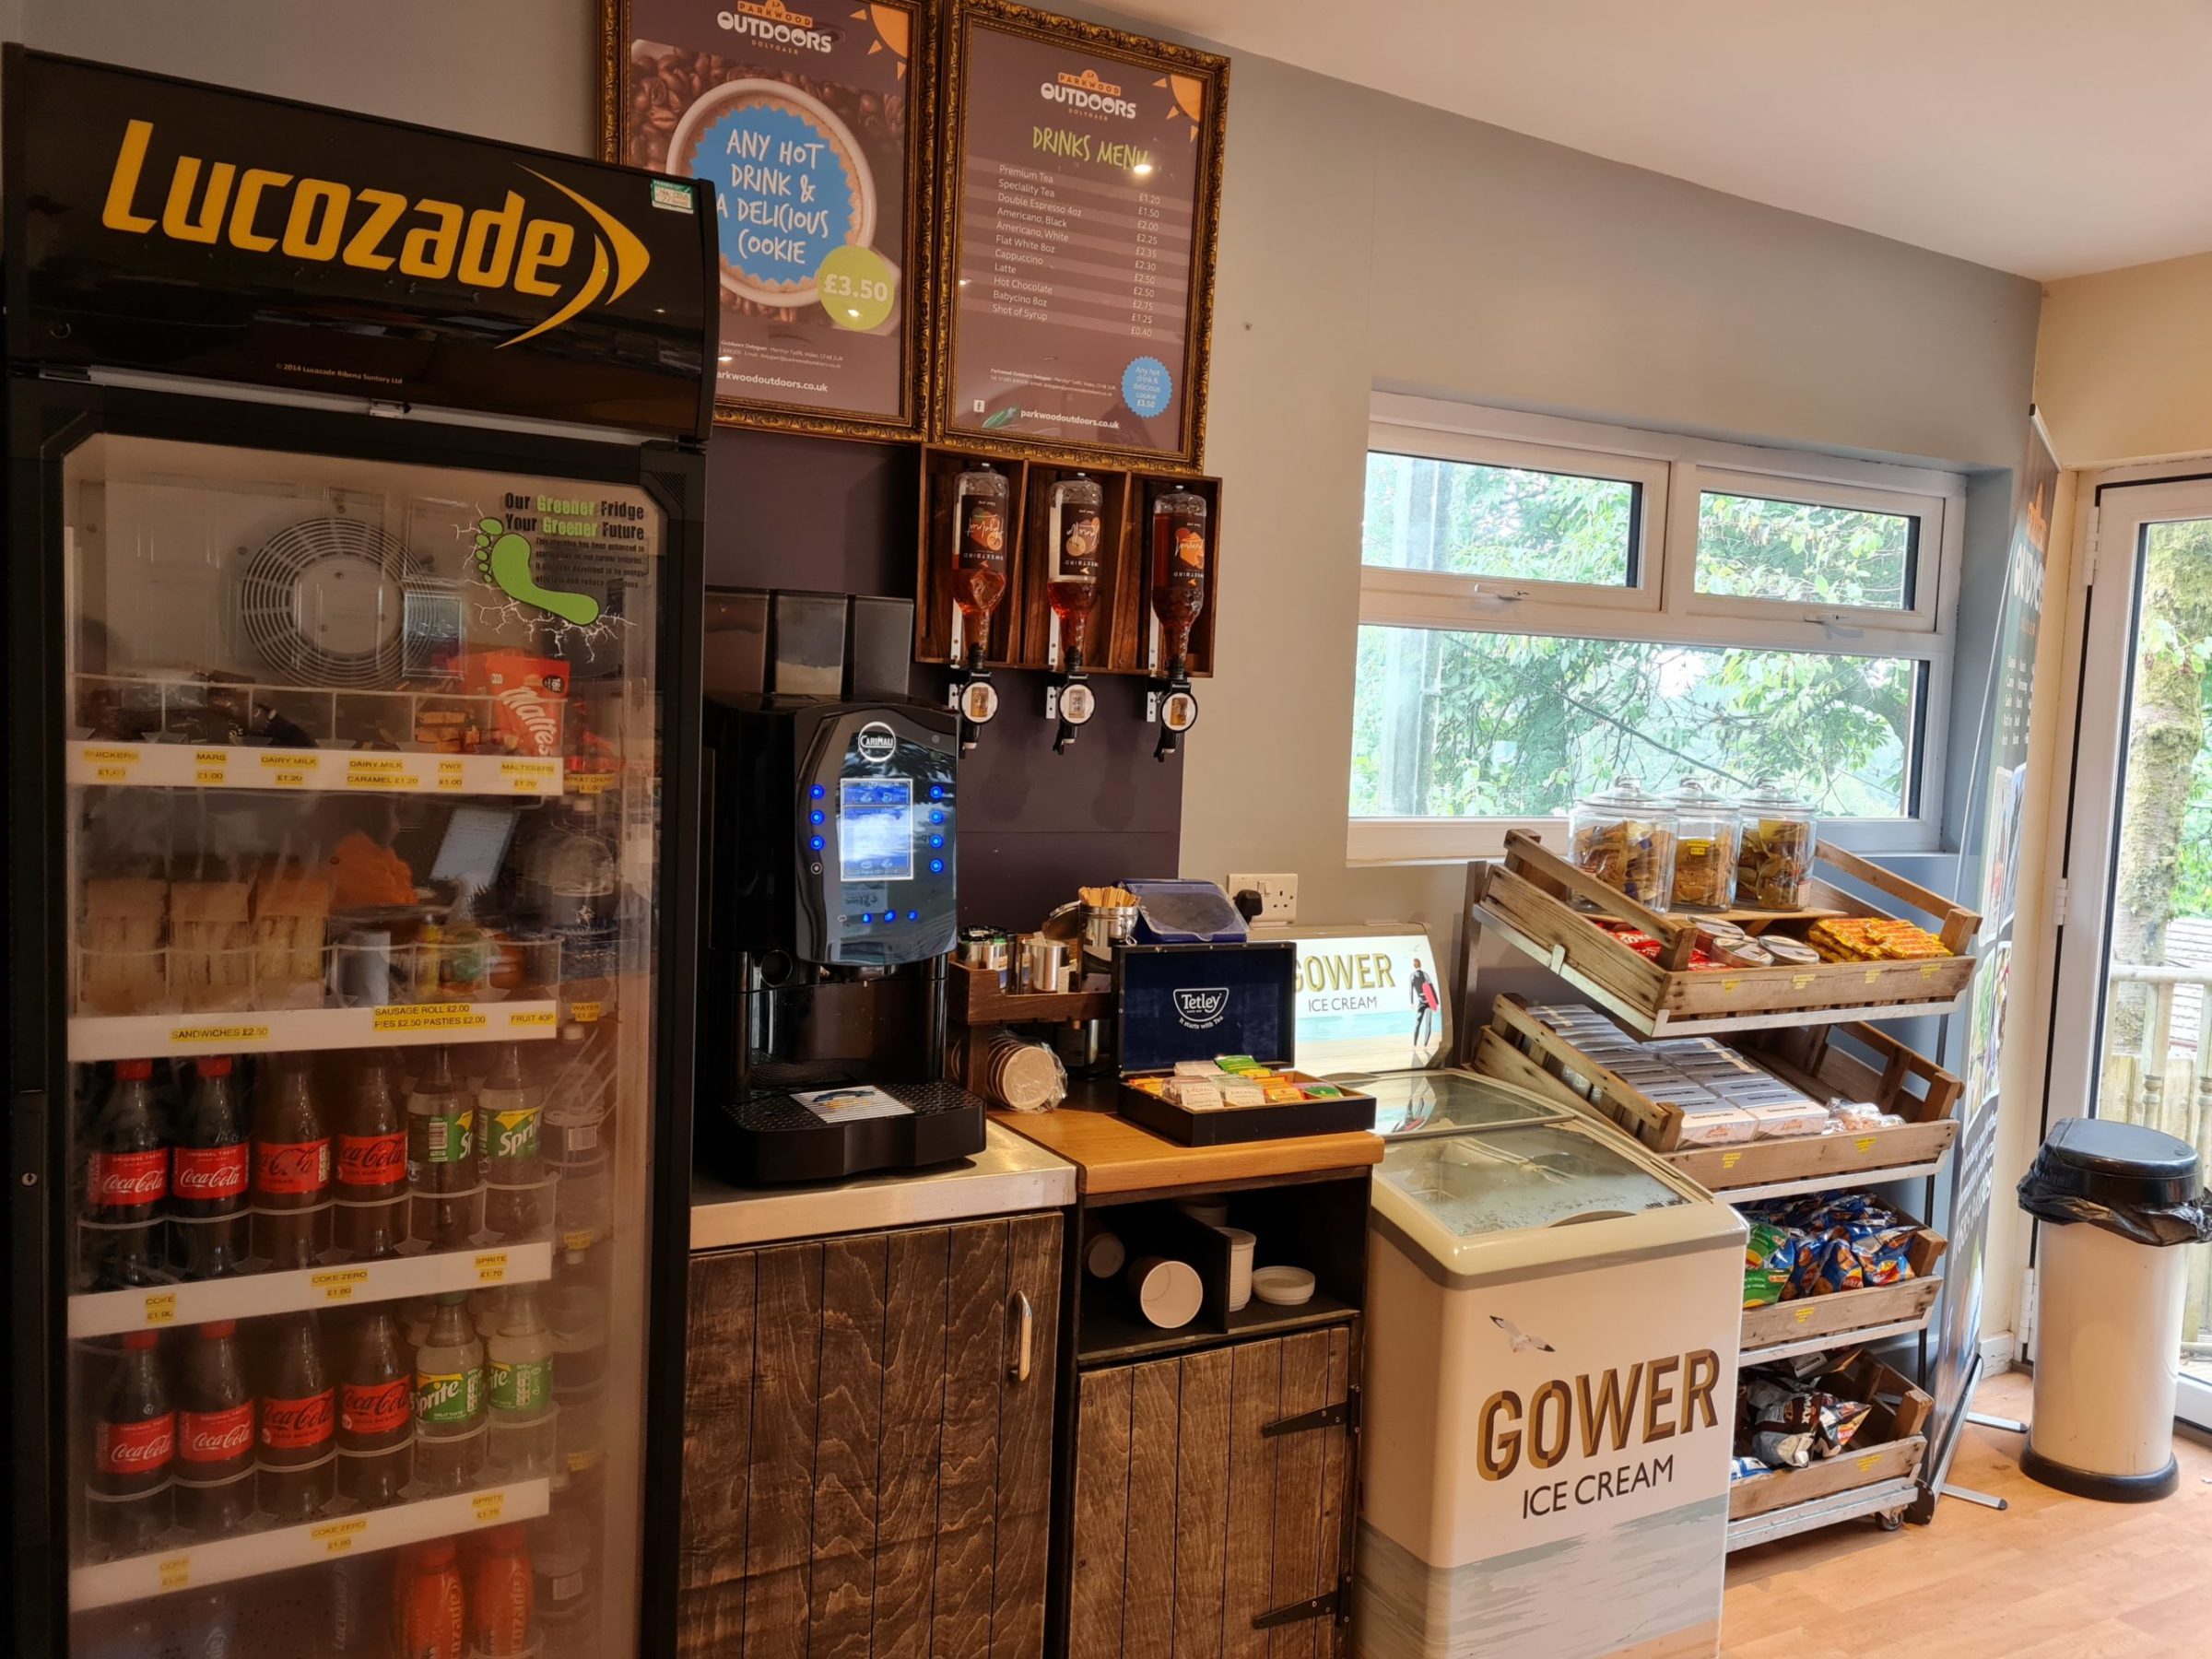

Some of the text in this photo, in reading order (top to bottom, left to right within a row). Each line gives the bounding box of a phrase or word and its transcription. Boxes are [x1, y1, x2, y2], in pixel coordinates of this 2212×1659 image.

[738, 3, 812, 27] PARKWOOD
[717, 11, 831, 53] OUTDOORS
[1059, 75, 1120, 95] PARKWOOD
[1041, 82, 1136, 119] OUTDOORS
[726, 129, 825, 170] ANY HOT
[1033, 126, 1090, 161] DRINKS
[731, 163, 815, 203] DRINK &
[999, 164, 1160, 205] Premium Tea £1.20
[998, 179, 1159, 218] Speciality Tea £1.50
[737, 196, 829, 238] DELICIOUS
[997, 194, 1159, 231] Double Espresso 4oz £2.00
[1043, 229, 1069, 242] White
[1135, 247, 1157, 258] £2.35
[1045, 217, 1067, 228] Black
[1136, 234, 1158, 245] £2.25
[738, 229, 806, 265] COOKIE
[995, 235, 1156, 271] Flat White 8oz £2.30
[995, 249, 1155, 285] Cappuccino £2.50
[824, 273, 888, 302] £3.50
[994, 264, 1154, 298] Latte £2.50
[994, 277, 1154, 311] Hot Chocolate £2.75
[994, 291, 1153, 324] Babycino 8oz £1.25
[992, 305, 1152, 336] Shot of Syrup £0.40
[283, 363, 301, 372] 2014
[303, 366, 335, 376] Lucozade
[337, 370, 361, 380] Ribena
[363, 373, 390, 384] Suntory
[717, 371, 828, 392] arkwoodoutdoors.co.uk
[1020, 408, 1120, 429] parkwoodoutdoors.co.uk
[505, 492, 644, 520] Our Greener Fridge
[505, 514, 644, 540] Your Greener Future
[963, 552, 1004, 561] SWEETBIRD
[1065, 559, 1099, 568] WEETBIRD
[497, 686, 557, 757] Maltes
[196, 753, 227, 762] MARS
[261, 757, 317, 766] DAIRY MILK
[348, 760, 403, 771] DAIRY MILK
[440, 762, 463, 771] TWIX
[501, 763, 554, 772] MALTESERS
[347, 776, 418, 785] CARAMEL £1.20
[375, 1004, 470, 1017] SAUSAGE ROLL £2.00
[1181, 994, 1219, 1014] Tetley
[1308, 996, 1378, 1013] ICE CREAM
[374, 1016, 486, 1029] PIES £2.50 PASTIES £2.00
[511, 1014, 554, 1023] FRUIT 40P
[1183, 1021, 1200, 1030] starts
[1200, 1021, 1214, 1030] with
[172, 1029, 240, 1040] SANDWICHES
[102, 1170, 163, 1194] Coca-Cola
[180, 1165, 240, 1188] Coca-Cola
[476, 1255, 507, 1265] SPRITE
[312, 1272, 368, 1284] COKE ZERO
[480, 1270, 503, 1278] £1.70
[146, 1296, 174, 1305] COKE
[1476, 1348, 1720, 1482] GOWER
[112, 1434, 171, 1462] Coca-Cola
[193, 1424, 250, 1452] Coca-Cola
[1524, 1454, 1674, 1520] ICE CREAM
